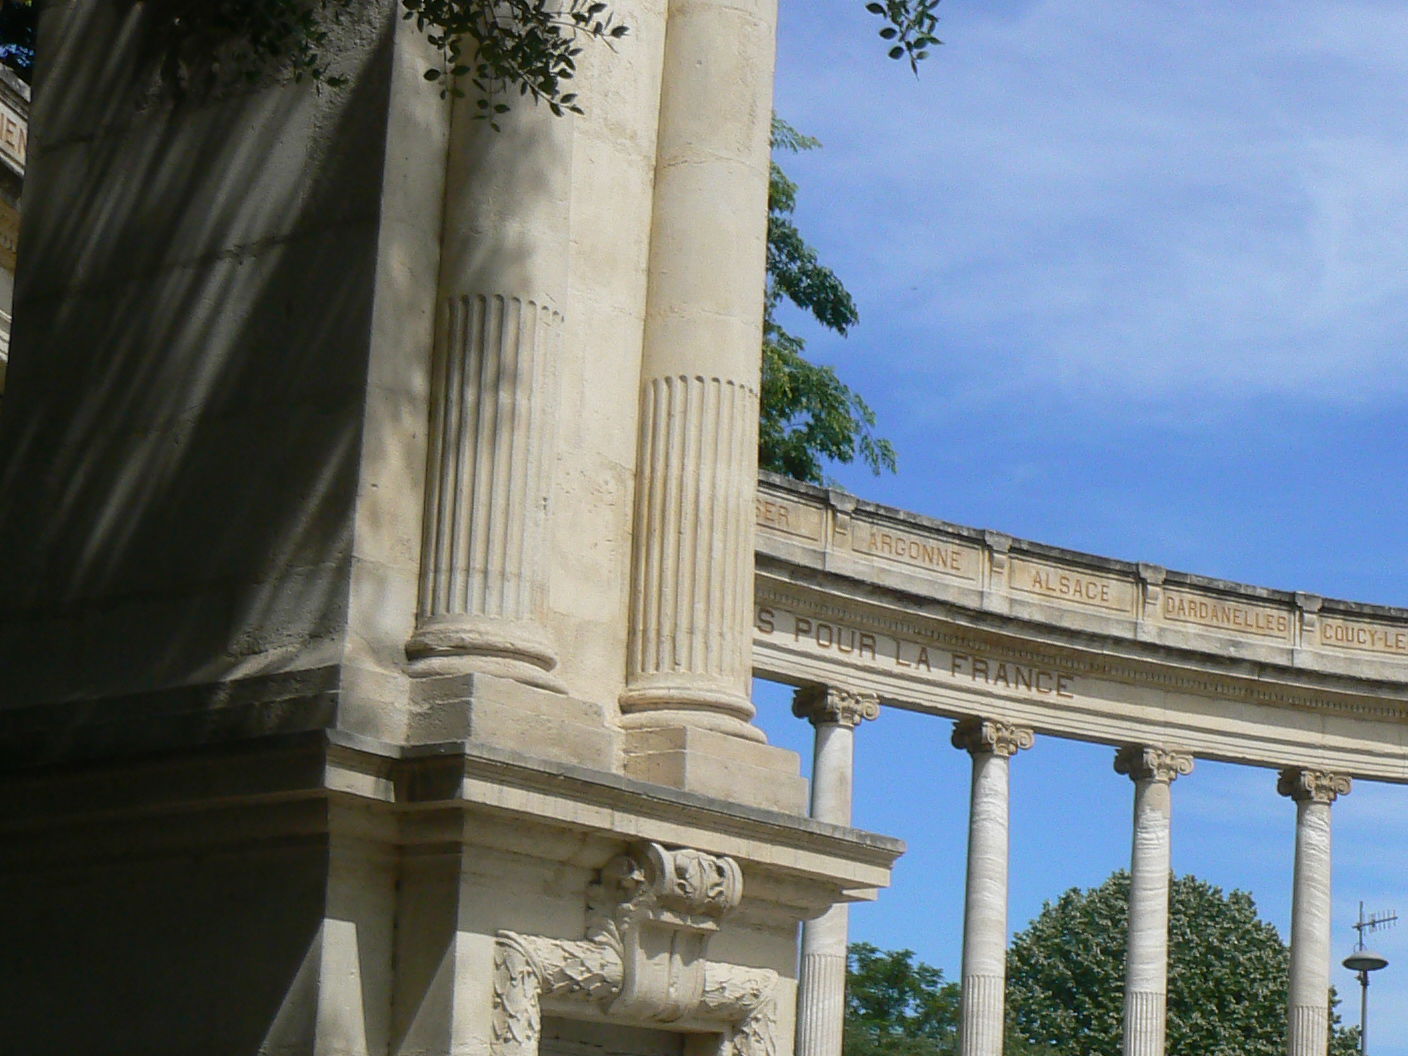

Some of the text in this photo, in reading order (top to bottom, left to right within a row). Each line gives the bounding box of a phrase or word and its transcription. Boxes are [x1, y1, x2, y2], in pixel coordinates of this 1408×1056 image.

[868, 530, 962, 571] ARGONNE
[1032, 569, 1110, 602] ALSACE
[1166, 596, 1289, 632] DARDANELLES
[794, 616, 877, 660] POUR
[896, 637, 931, 672] LA
[951, 653, 1075, 698] FRANCE
